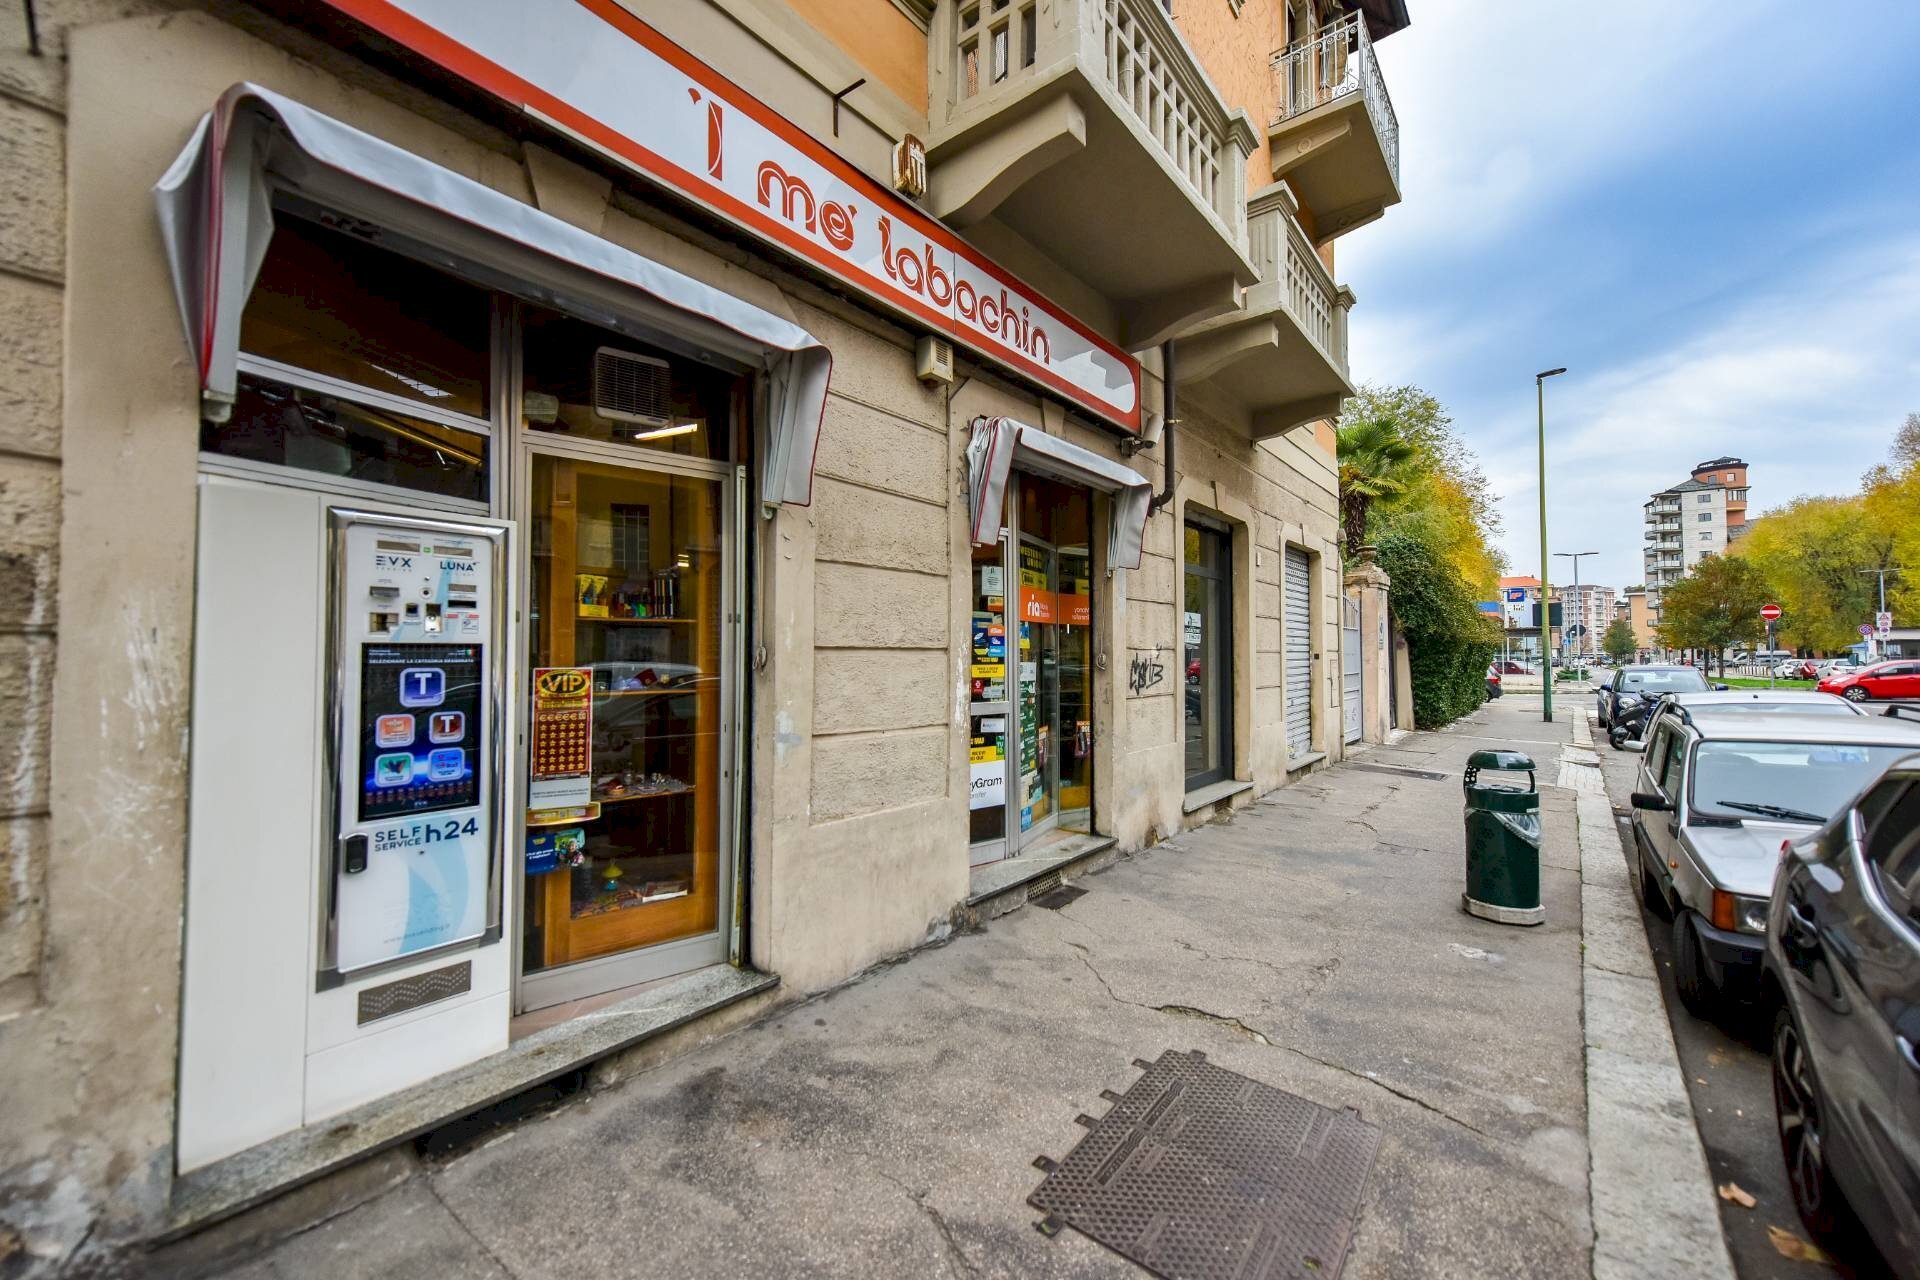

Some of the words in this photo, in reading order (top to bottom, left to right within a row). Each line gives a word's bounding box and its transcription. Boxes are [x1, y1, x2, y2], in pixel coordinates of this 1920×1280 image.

[375, 555, 412, 568] EVX
[440, 560, 474, 572] LUNA
[414, 672, 433, 695] T
[545, 674, 583, 692] VIP
[970, 777, 1002, 791] yGram
[375, 826, 422, 843] SELF
[425, 817, 479, 843] h24
[375, 837, 421, 852] SERVICE
